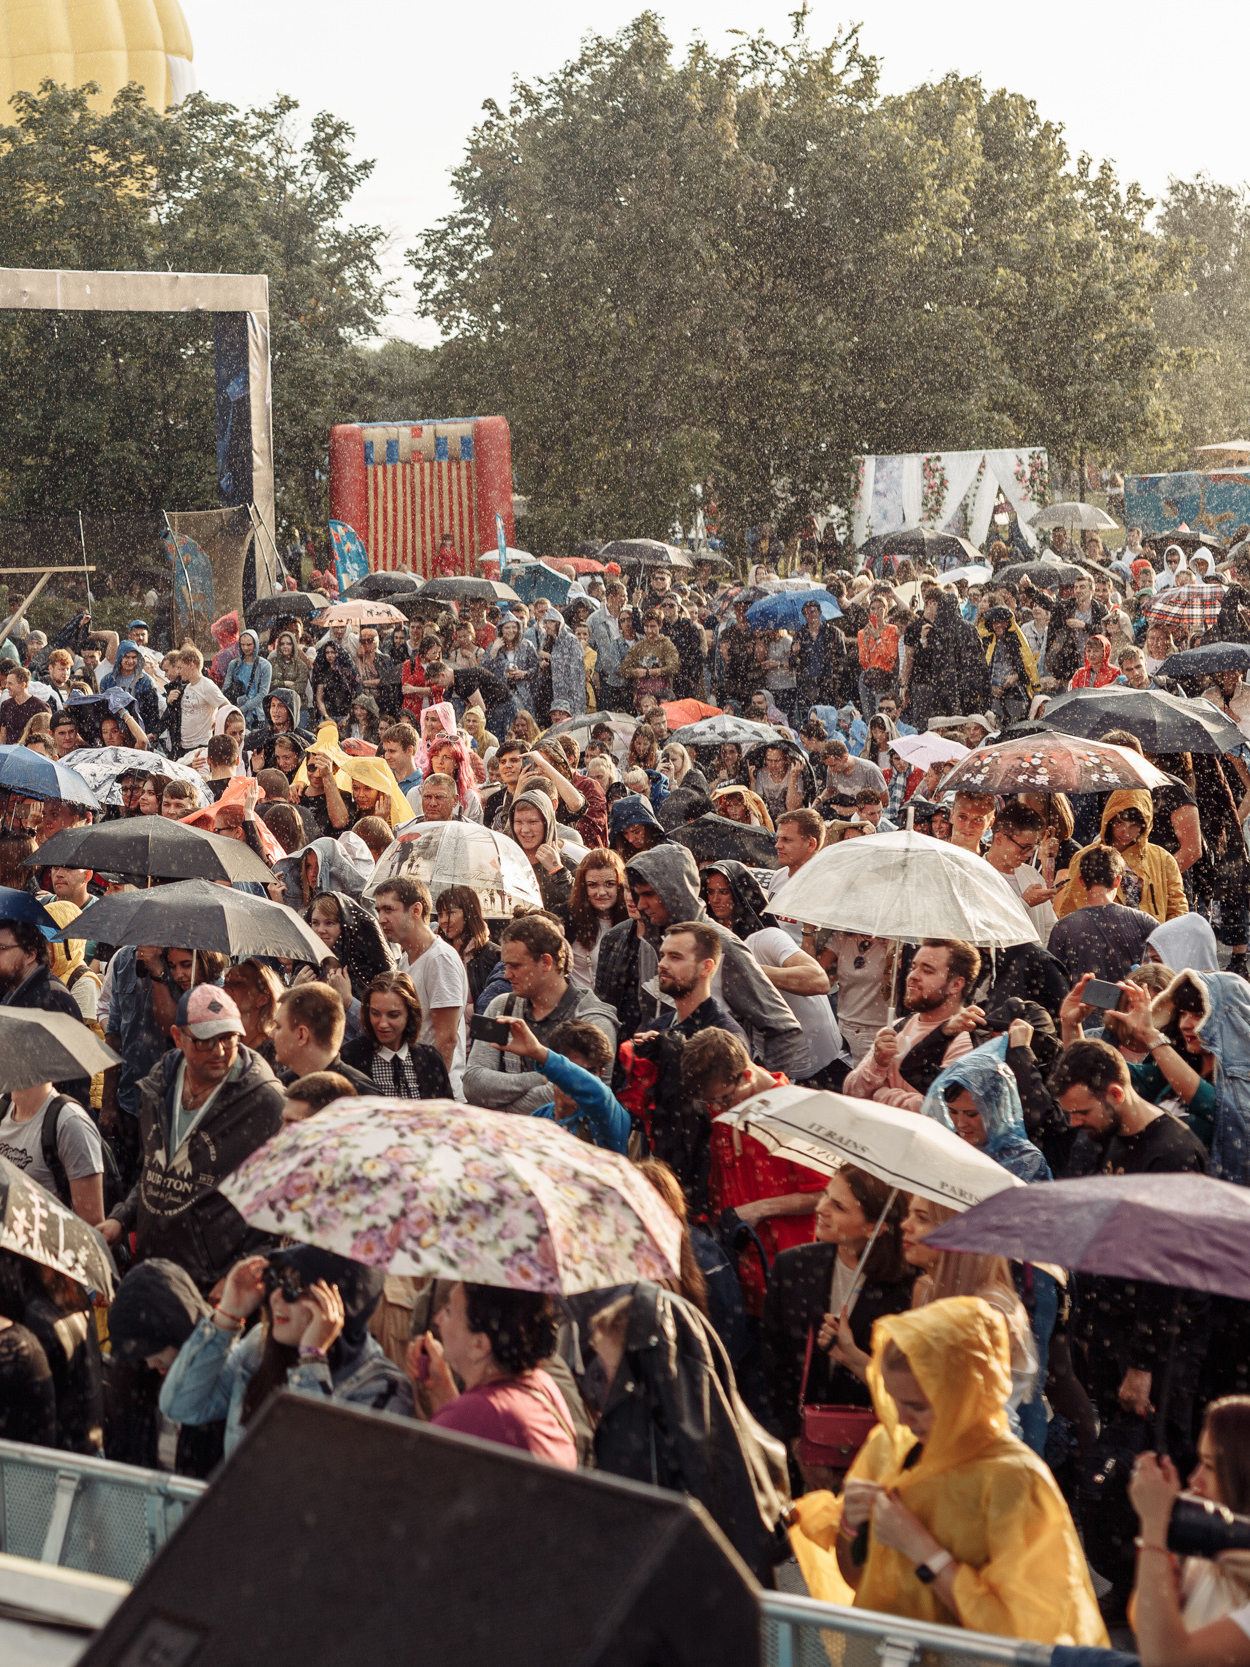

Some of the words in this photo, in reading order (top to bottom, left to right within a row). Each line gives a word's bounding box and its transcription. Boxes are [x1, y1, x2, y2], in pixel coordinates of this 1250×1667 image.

[807, 1122, 826, 1132] IT
[824, 1130, 870, 1154] RAINS
[146, 1170, 194, 1194] BURTON
